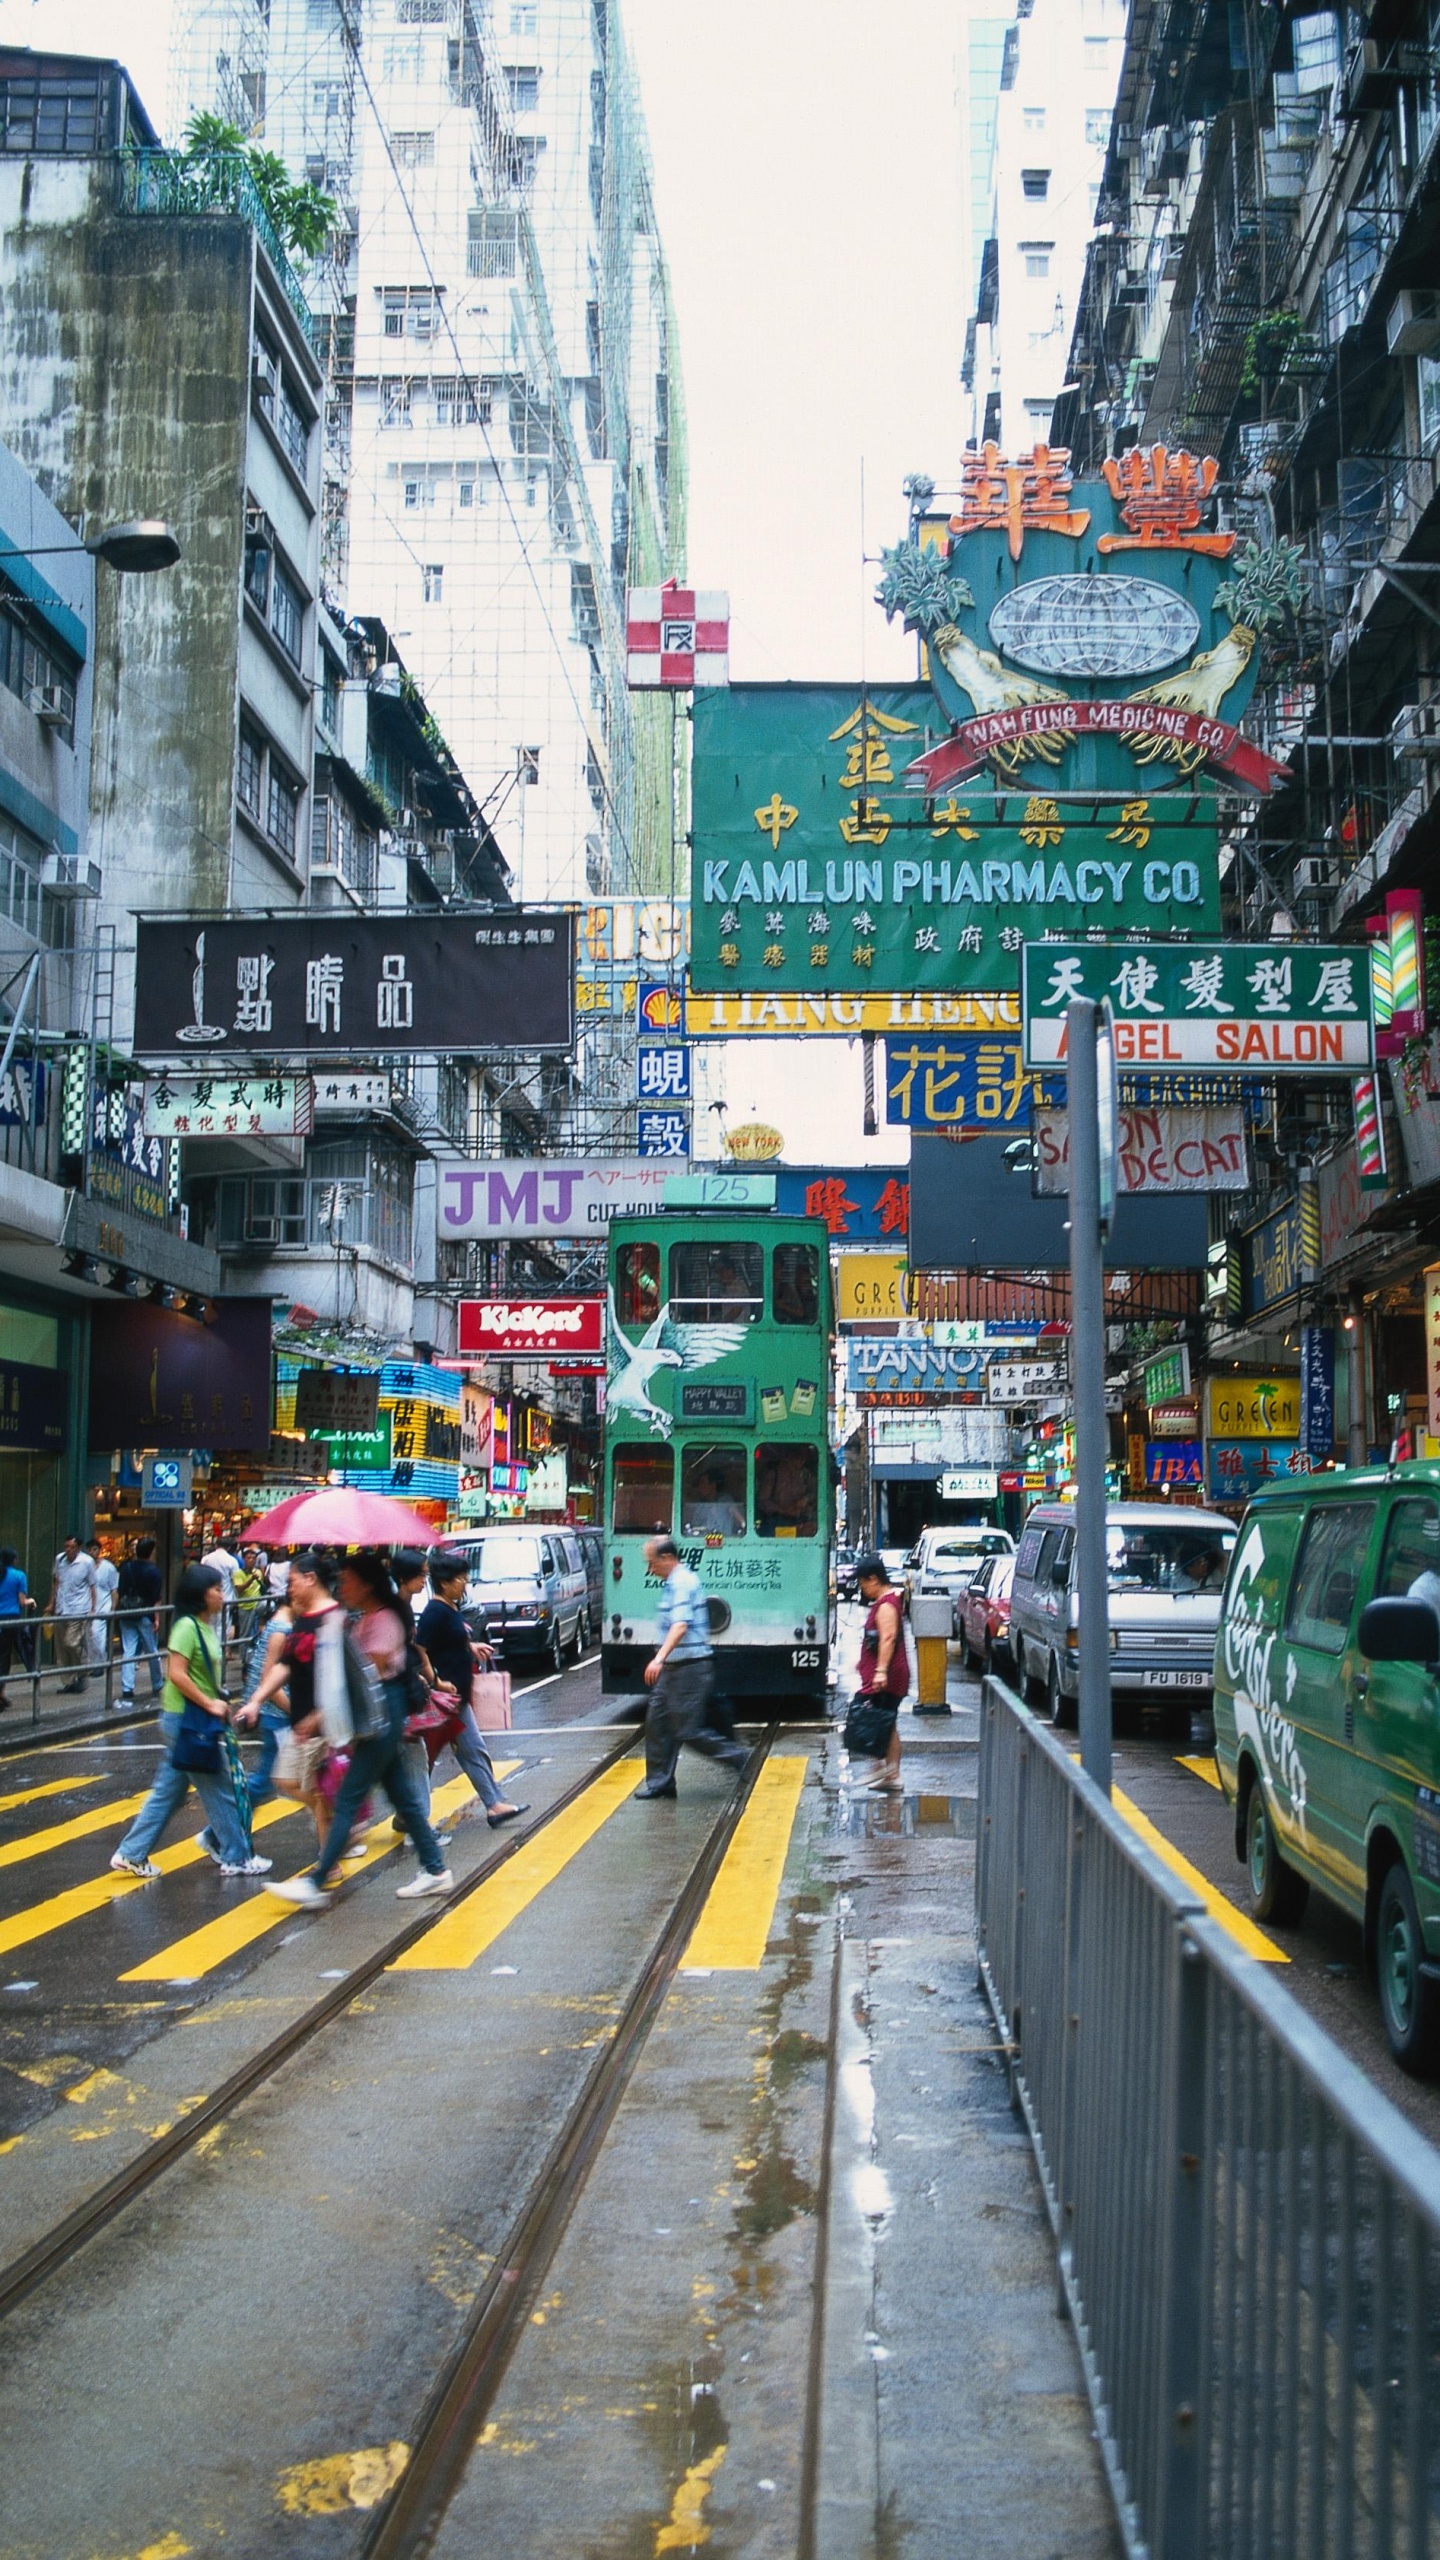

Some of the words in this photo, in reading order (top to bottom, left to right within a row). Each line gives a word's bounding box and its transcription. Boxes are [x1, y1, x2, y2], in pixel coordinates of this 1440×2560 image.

[966, 715, 1017, 746] WAH
[1021, 709, 1077, 731] FUNG
[1089, 705, 1189, 736] MEDICINE
[828, 699, 920, 789] 金
[703, 860, 884, 904] KAMLUN
[892, 860, 1132, 904] PHARMACY
[1143, 860, 1205, 906] CO.
[1041, 955, 1359, 1013] 天使髮型屋
[1057, 1024, 1182, 1060] GEL
[1216, 1023, 1342, 1061] SALON
[728, 1136, 750, 1149] NEW
[753, 1136, 781, 1149] YORK
[588, 1170, 683, 1186] ヘアーサロ
[701, 1178, 749, 1201] 125
[444, 1170, 584, 1226] JMJ
[685, 1388, 712, 1400] HAPPY
[715, 1387, 743, 1400] VALLEY
[1219, 1401, 1292, 1422] GREEN
[791, 1650, 820, 1668] 125
[1150, 1672, 1168, 1685] FU
[1175, 1672, 1203, 1686] 1619
